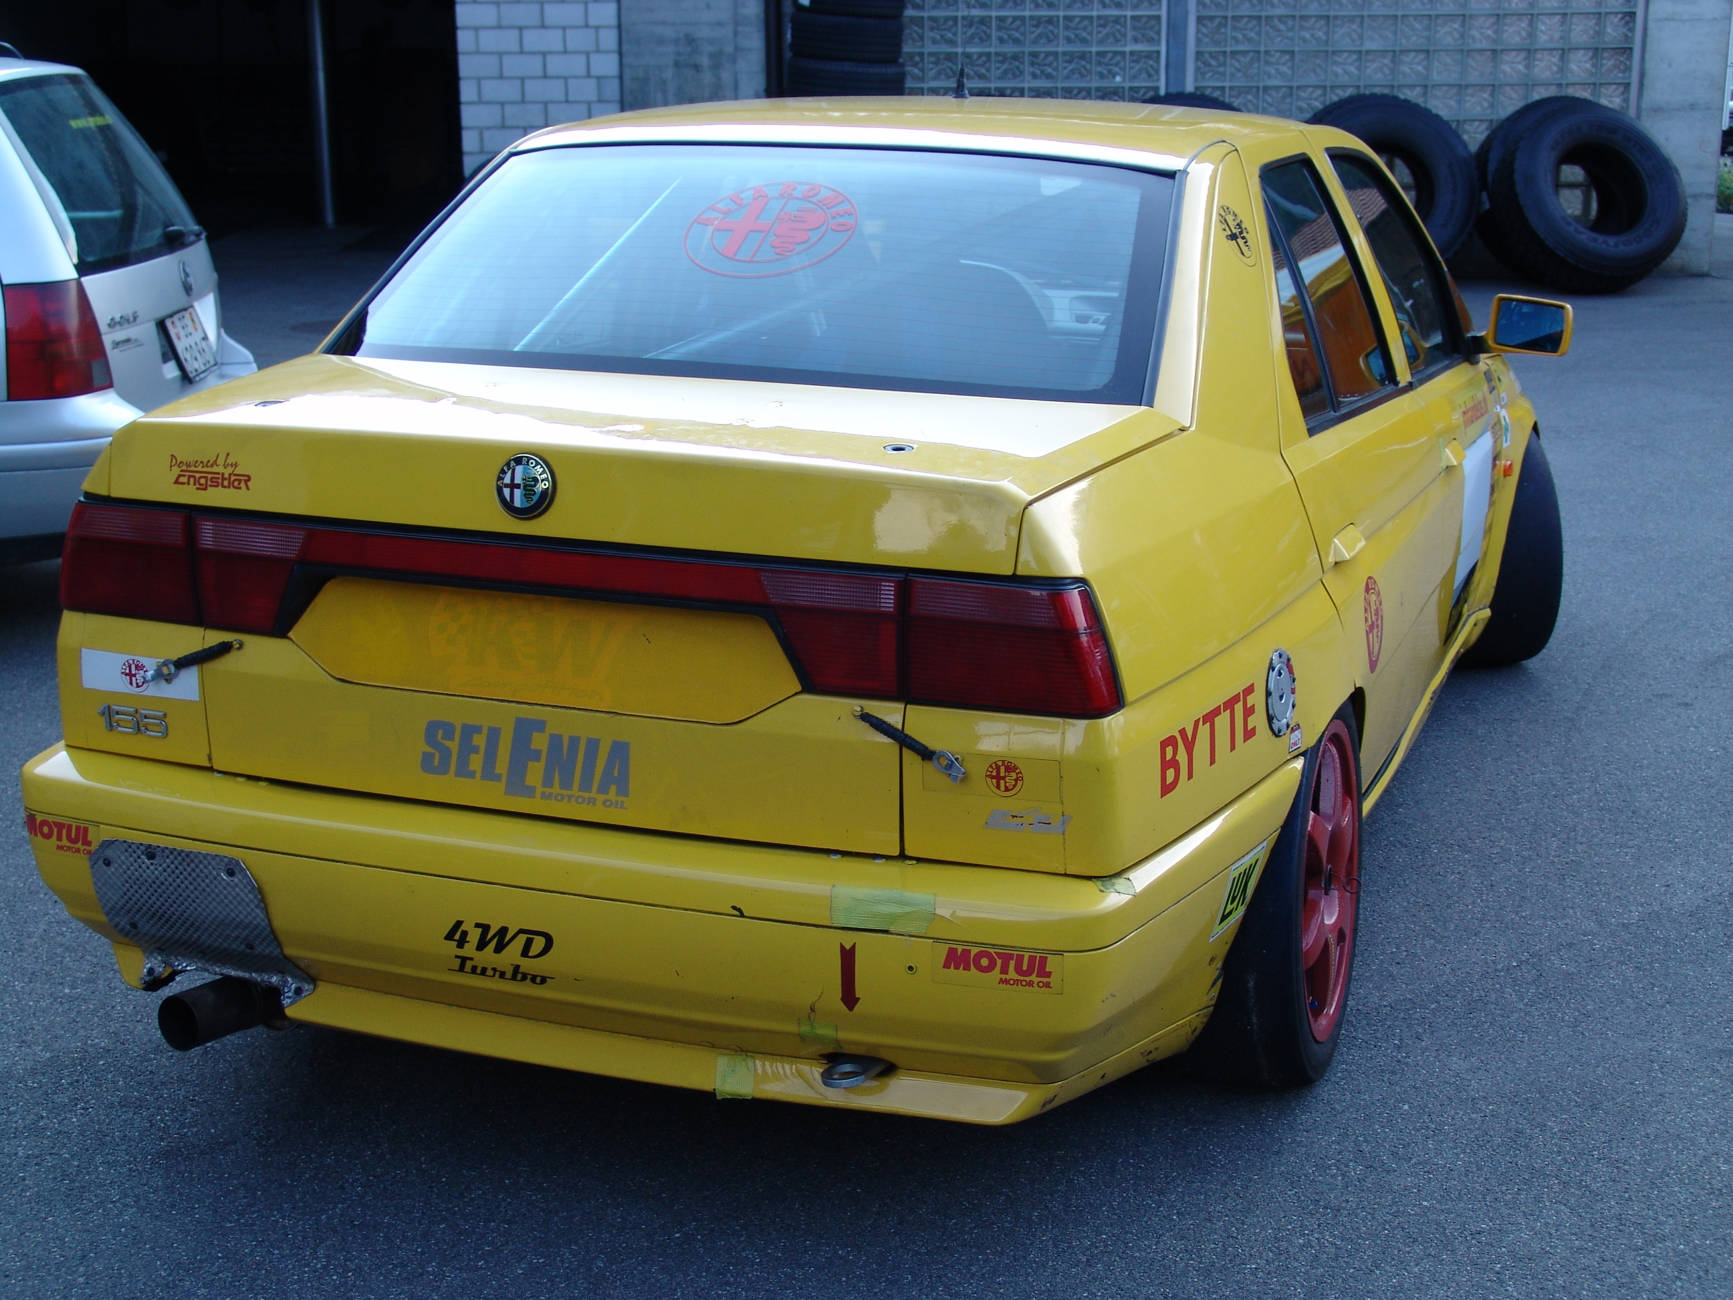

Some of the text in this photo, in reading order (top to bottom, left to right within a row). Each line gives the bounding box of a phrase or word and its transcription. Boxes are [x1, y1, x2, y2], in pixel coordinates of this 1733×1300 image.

[694, 182, 854, 232] ALFA ROMEO
[169, 452, 240, 474] Powered by
[497, 457, 549, 489] ALFA ROMEO
[98, 704, 168, 738] 155
[1159, 682, 1257, 799] BYTTE
[420, 717, 631, 799] SELENIA
[541, 790, 628, 810] MOTOR OIL
[26, 814, 93, 847] MOTUL
[443, 920, 554, 959] 4WD
[448, 954, 555, 986] Turbo
[943, 946, 1053, 979] MOTUL
[998, 977, 1053, 989] MOTOR OIL
